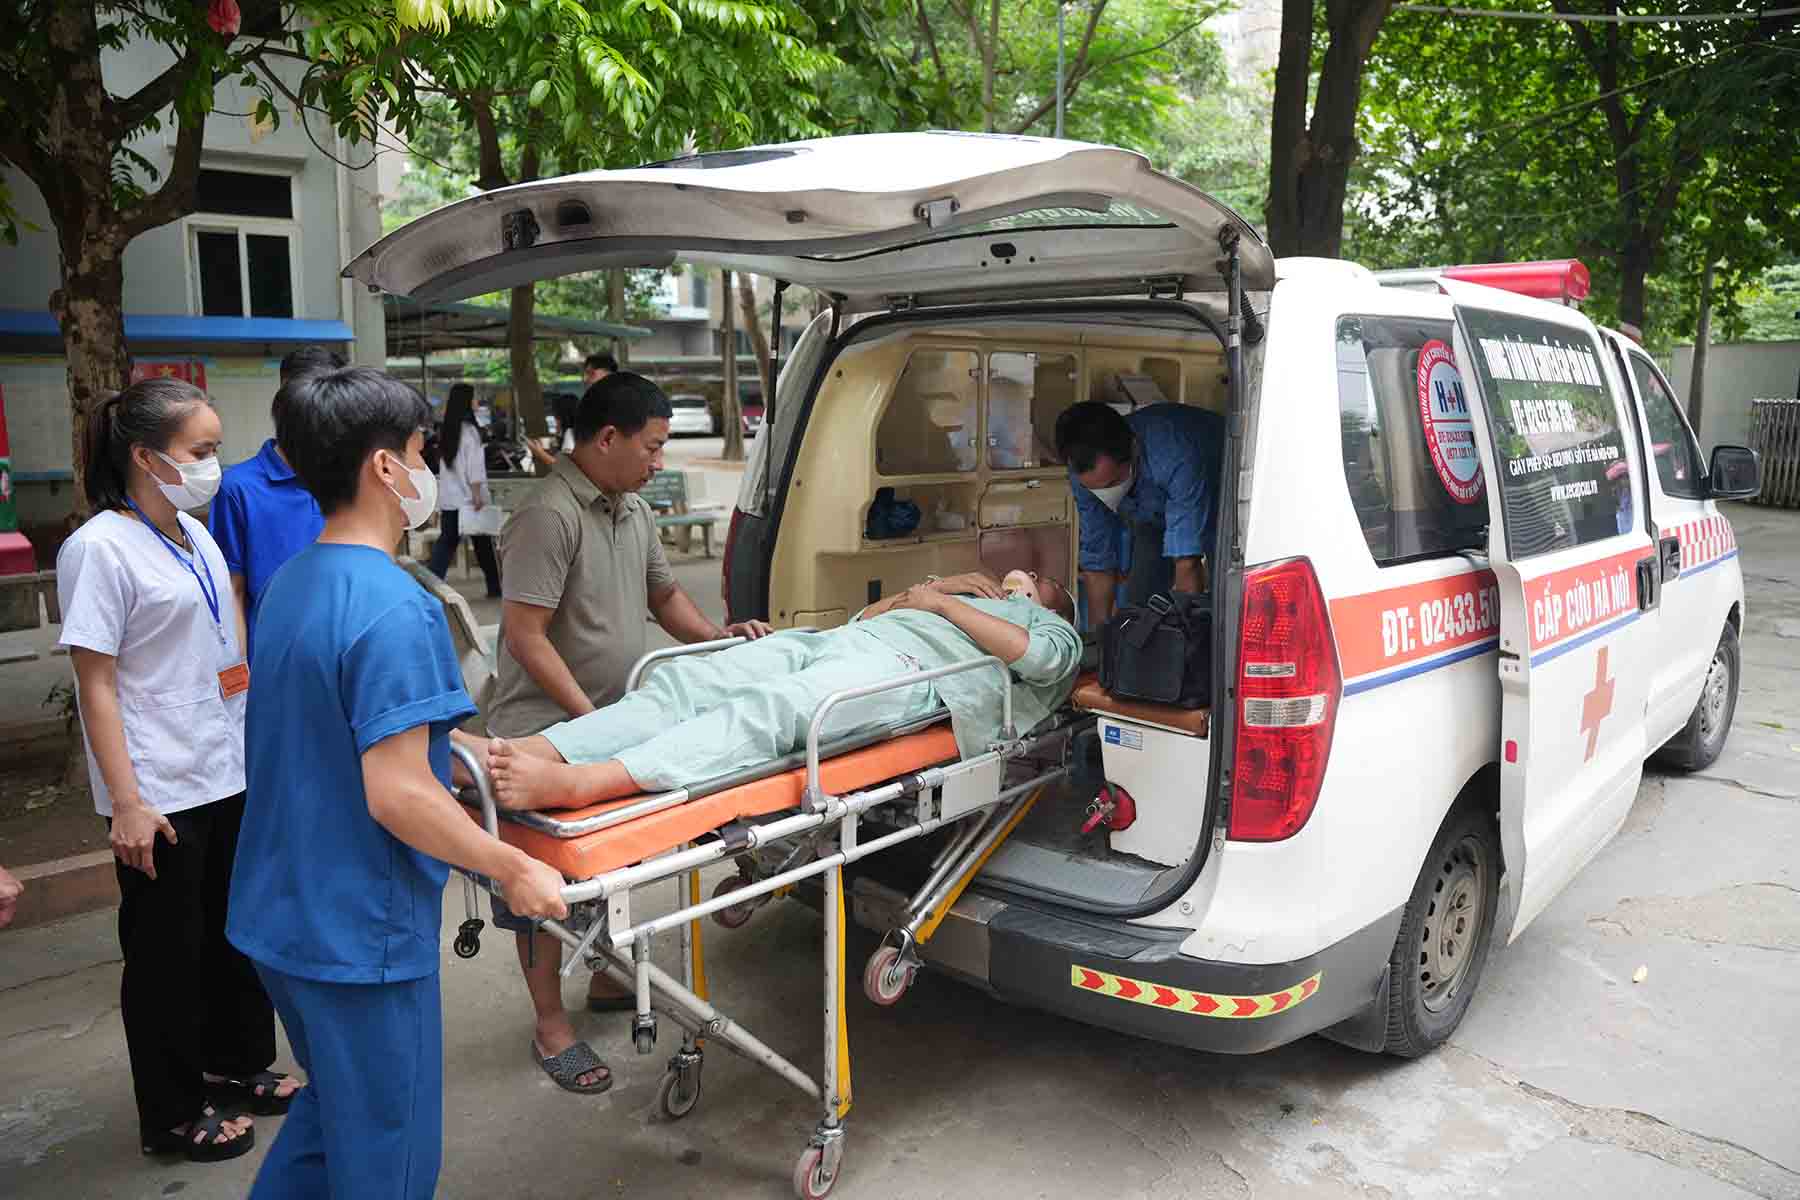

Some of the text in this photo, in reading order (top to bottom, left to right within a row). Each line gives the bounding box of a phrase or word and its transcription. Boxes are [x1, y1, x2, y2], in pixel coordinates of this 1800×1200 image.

[1382, 607, 1416, 657] ĐT:
[1534, 564, 1630, 641] CẤP CỨU HÀ NỘI
